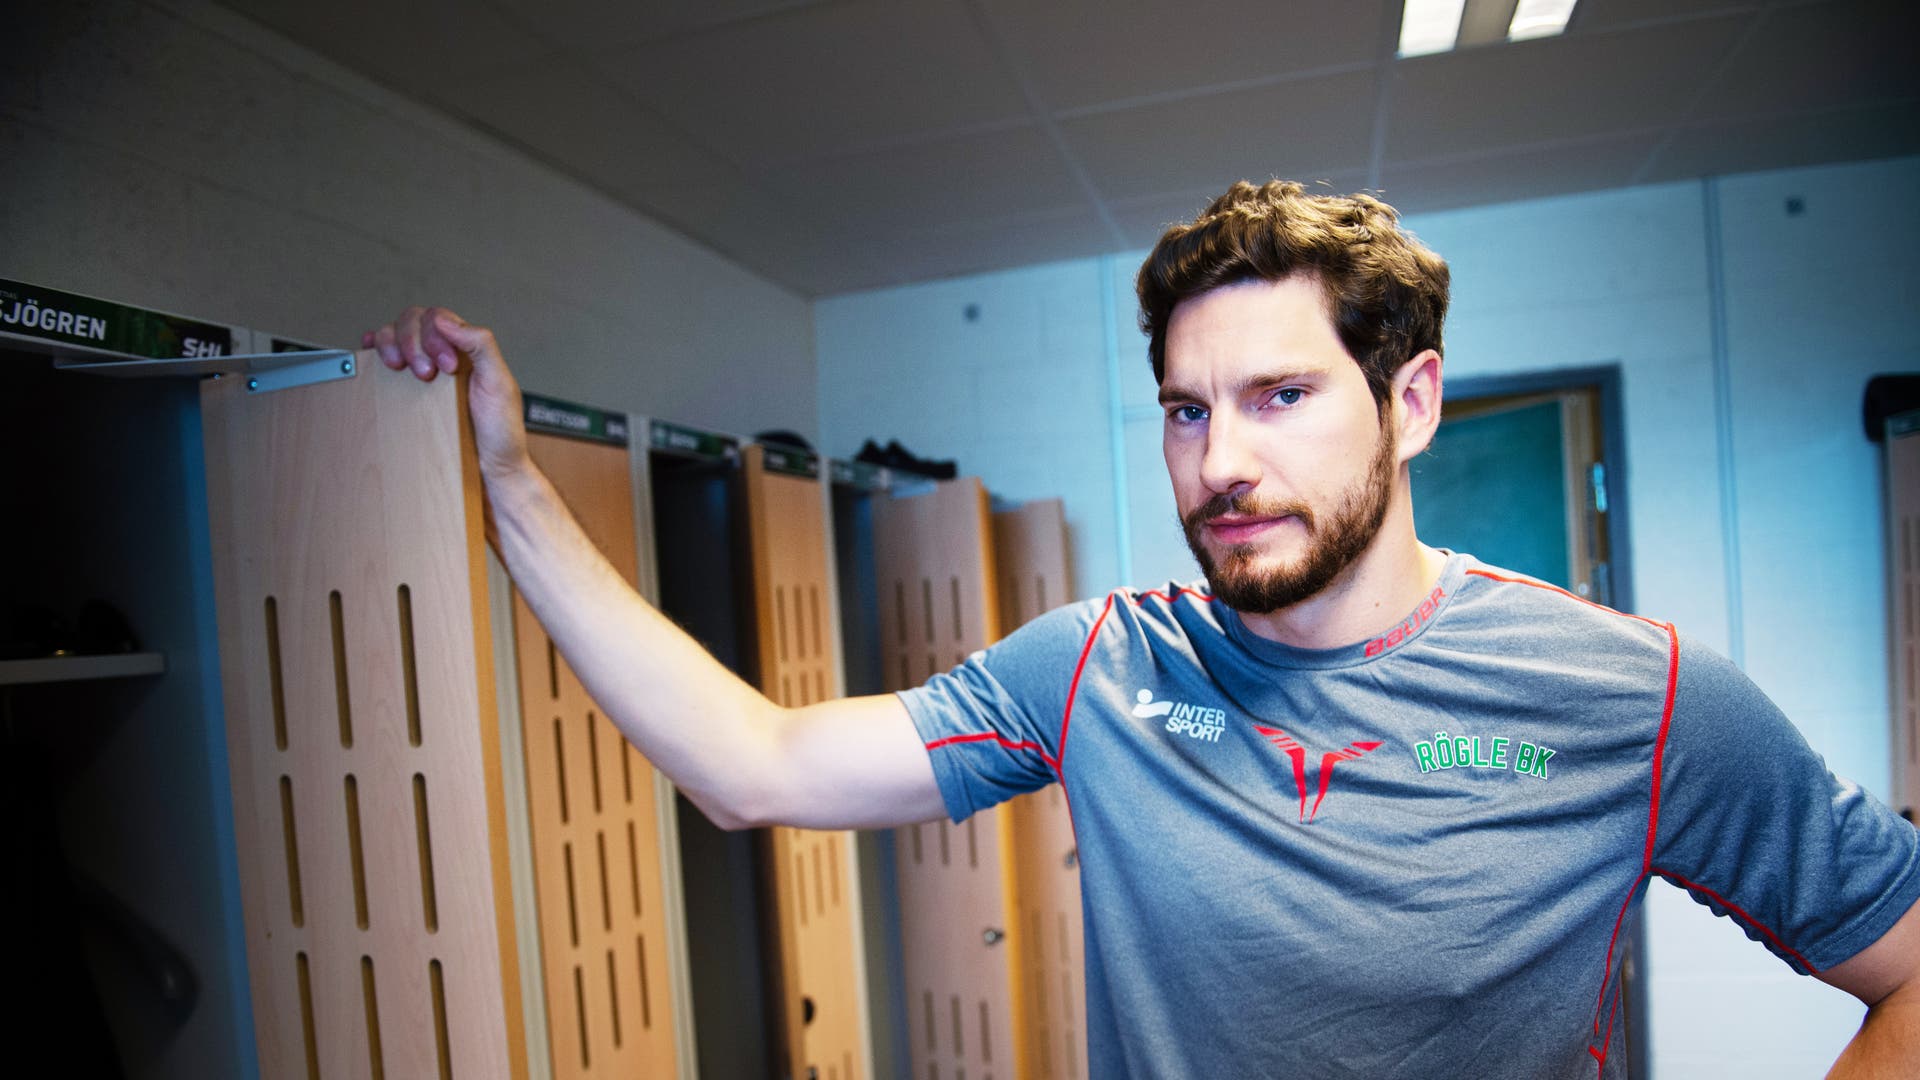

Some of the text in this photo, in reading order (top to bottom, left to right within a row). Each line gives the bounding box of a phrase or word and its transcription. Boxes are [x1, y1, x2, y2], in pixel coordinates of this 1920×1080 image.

[0, 298, 107, 341] JÖGREN
[1364, 587, 1447, 658] BAUER
[1165, 717, 1226, 743] SPORT
[1172, 702, 1226, 726] INTER
[1414, 731, 1556, 780] RÖGLE BK
